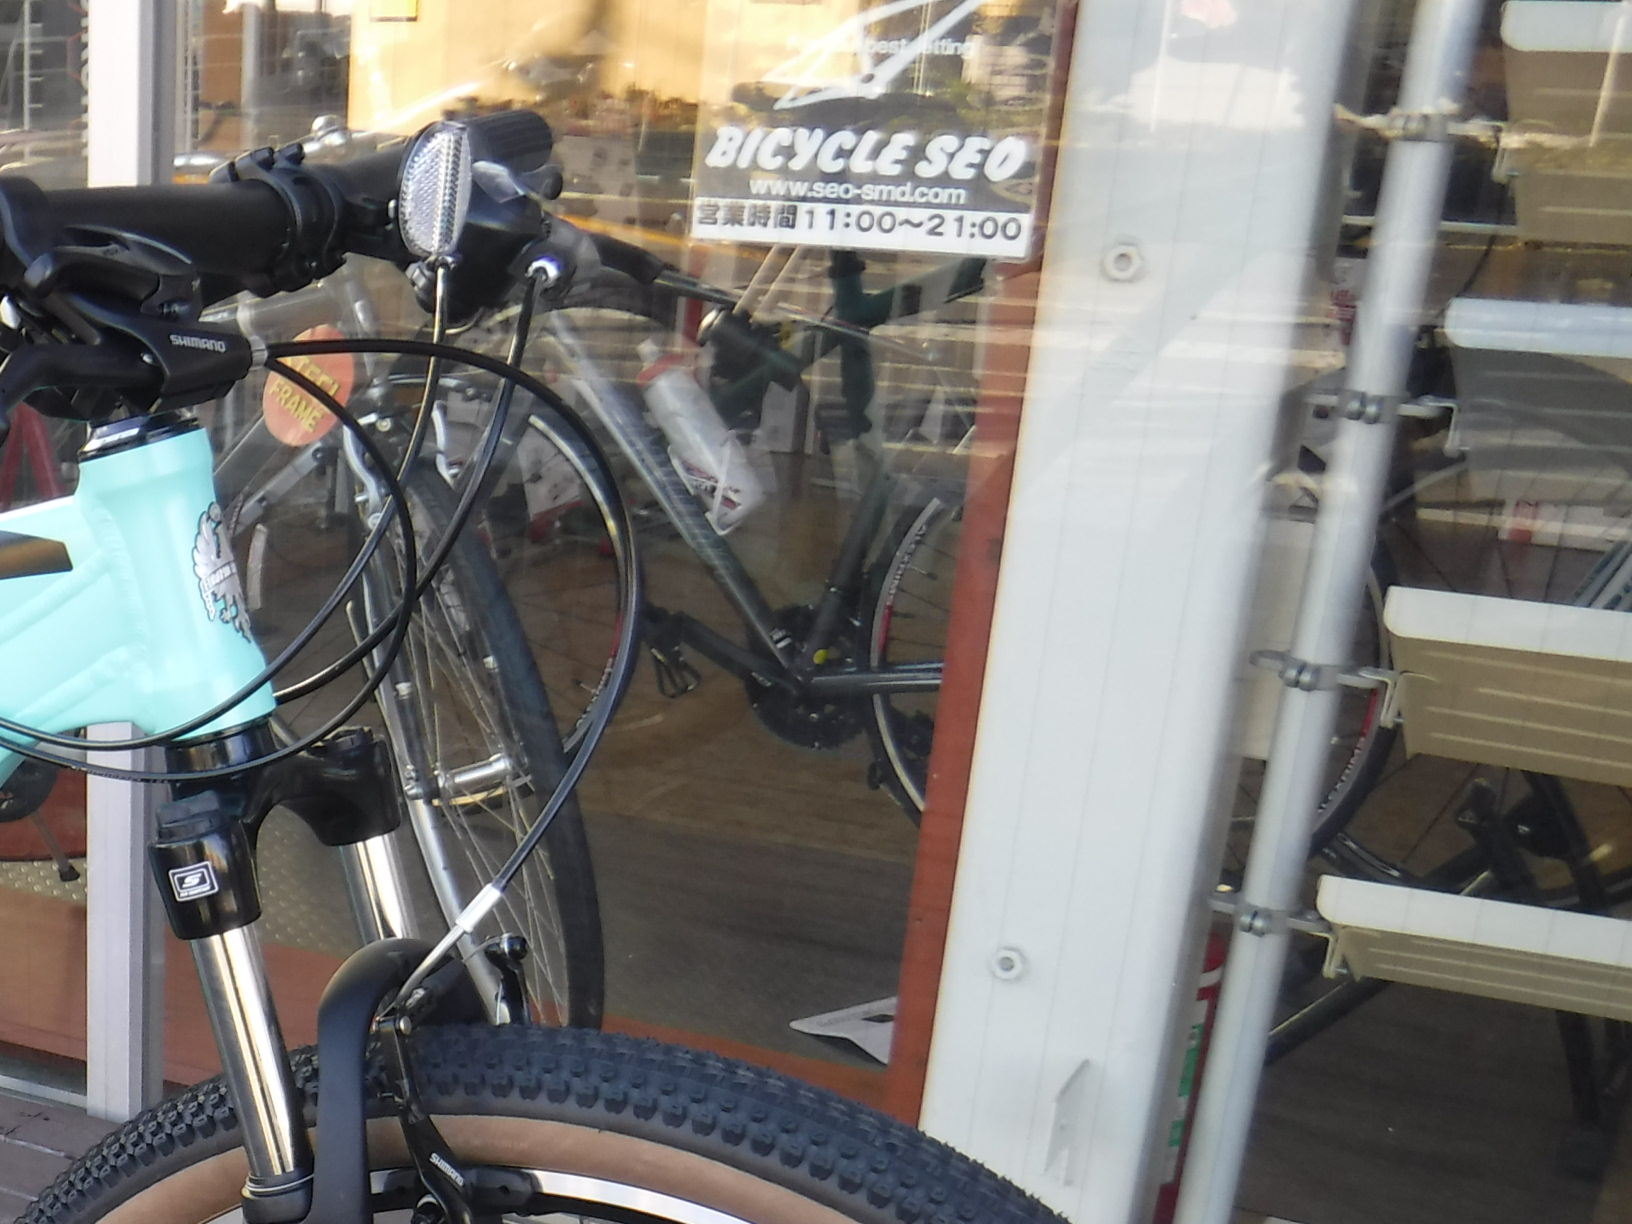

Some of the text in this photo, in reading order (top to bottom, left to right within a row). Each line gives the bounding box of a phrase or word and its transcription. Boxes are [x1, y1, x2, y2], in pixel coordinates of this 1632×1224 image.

[704, 125, 1029, 182] BICYCLE SEO
[749, 179, 967, 205] www.seo-smd.com
[697, 204, 798, 230] 営業時間
[169, 333, 227, 354] SHIMANO
[269, 378, 325, 432] FRAME
